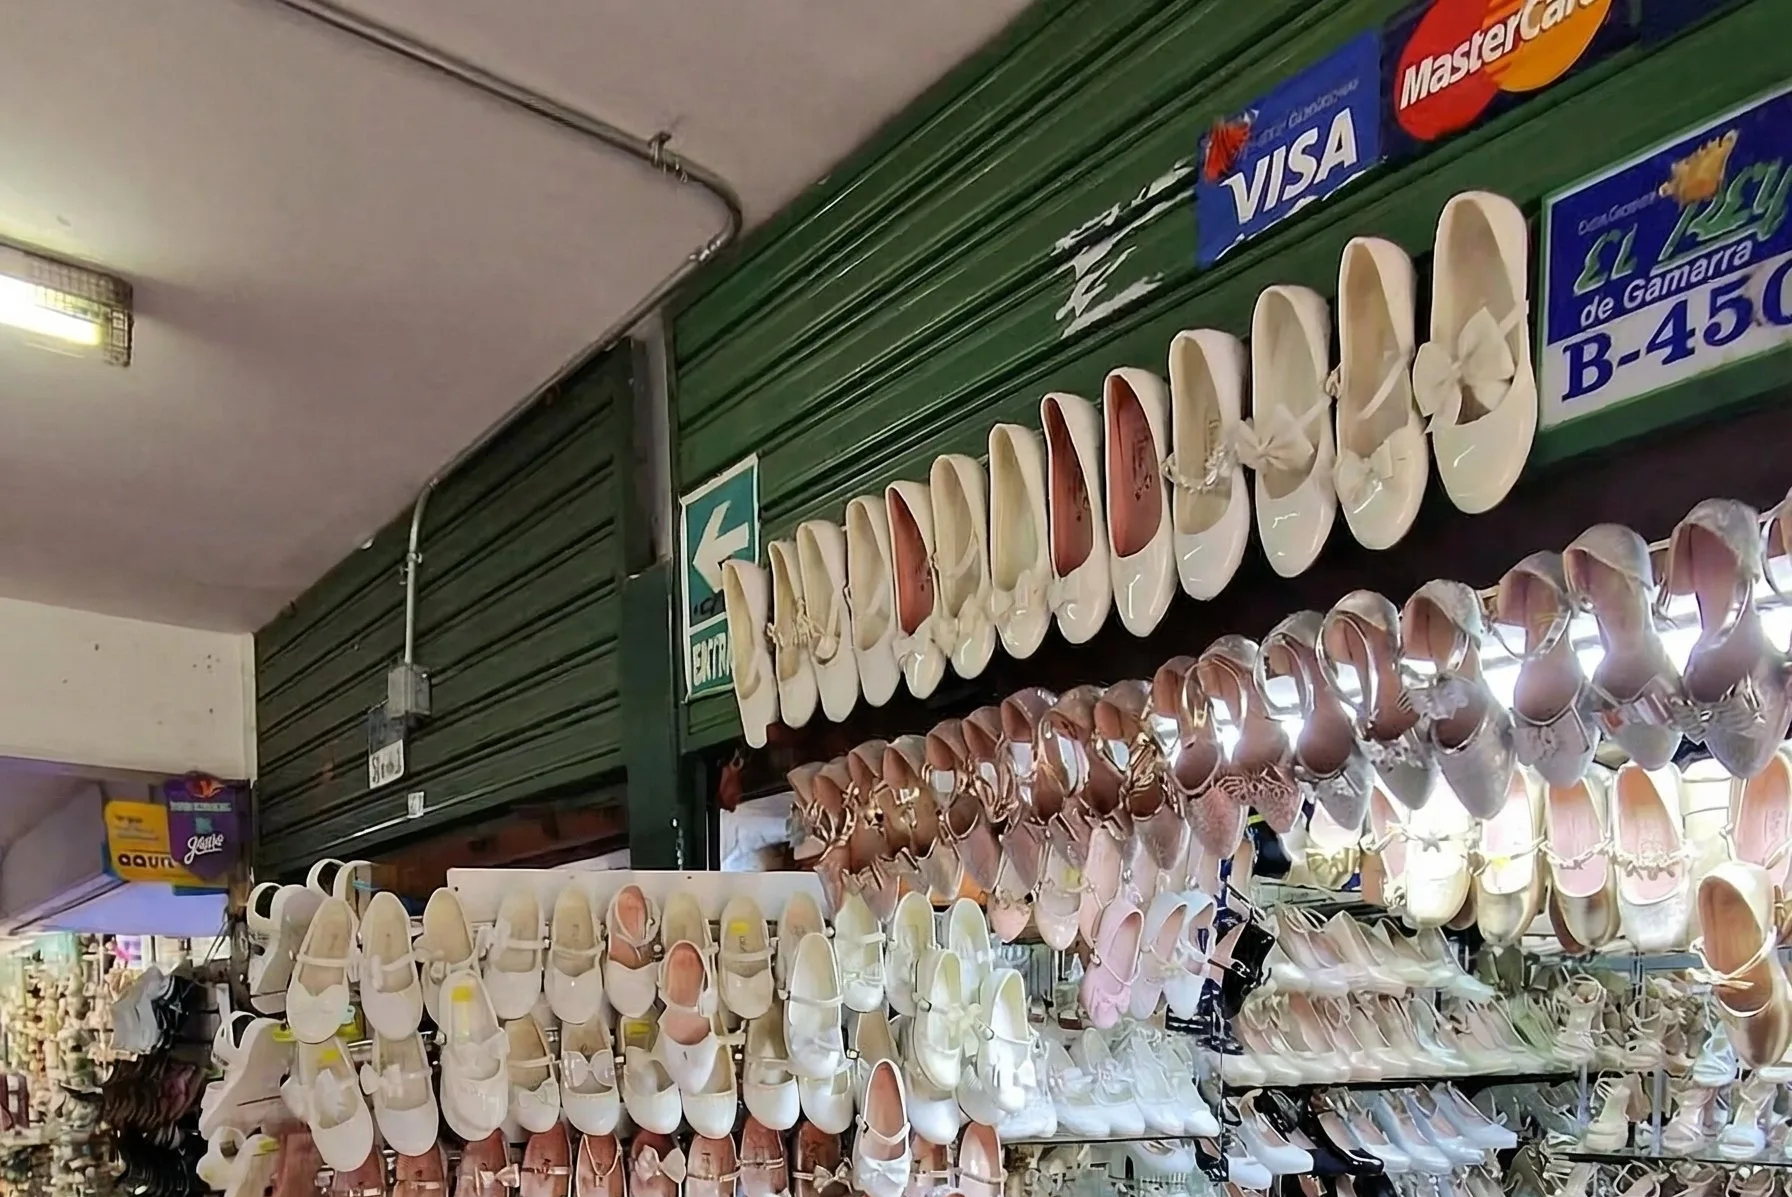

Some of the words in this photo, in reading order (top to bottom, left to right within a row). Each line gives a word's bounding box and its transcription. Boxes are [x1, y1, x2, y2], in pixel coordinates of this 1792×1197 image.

[1400, 0, 1597, 110] MasterCa
[1219, 107, 1358, 224] VISA
[1580, 295, 1614, 328] de
[1623, 239, 1753, 309] Gamarra
